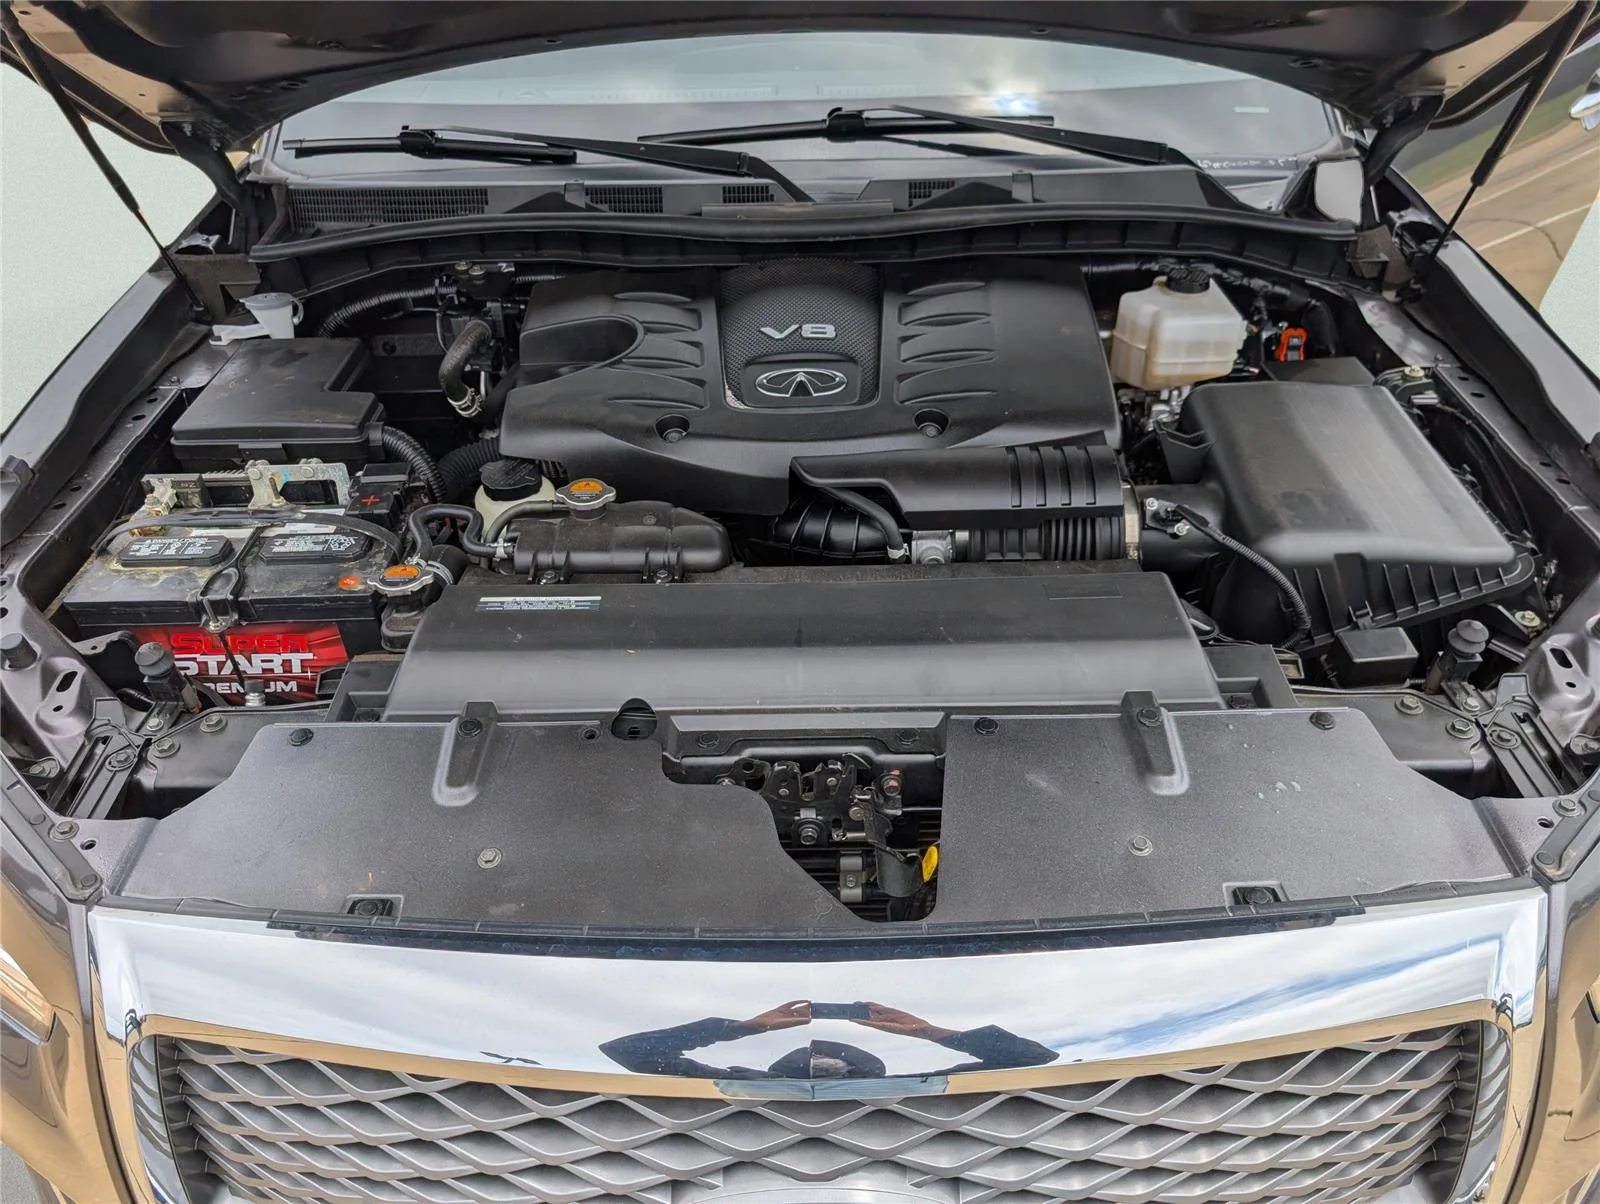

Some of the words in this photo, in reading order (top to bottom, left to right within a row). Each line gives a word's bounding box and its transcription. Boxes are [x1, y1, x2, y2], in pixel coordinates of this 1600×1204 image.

[760, 324, 836, 338] V8
[171, 633, 309, 653] SUPER
[173, 652, 314, 676] START
